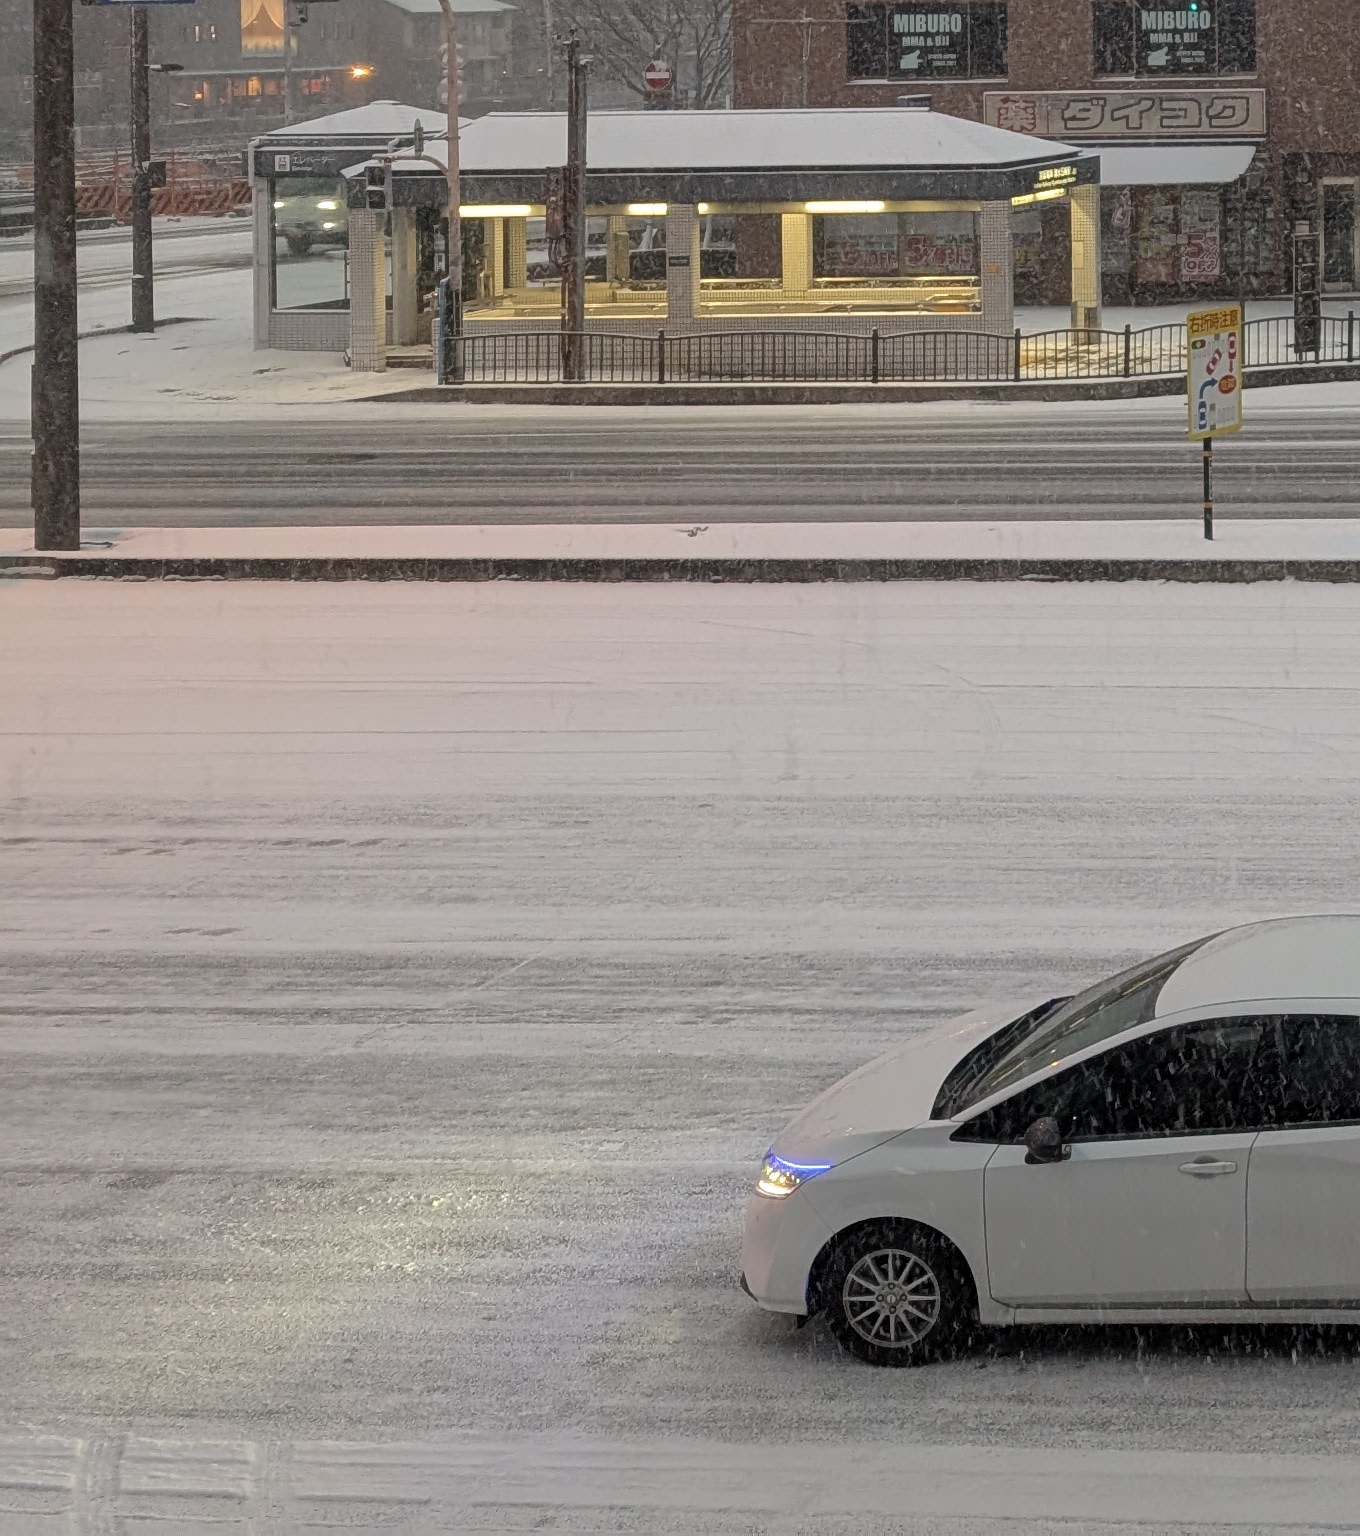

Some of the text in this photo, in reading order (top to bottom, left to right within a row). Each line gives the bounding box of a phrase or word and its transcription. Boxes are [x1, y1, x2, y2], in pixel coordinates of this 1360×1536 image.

[893, 13, 962, 33] MIBURO
[1141, 10, 1211, 30] MIBURO
[902, 35, 925, 47] MMA
[1149, 32, 1173, 44] MMA
[997, 96, 1250, 132] 薬 ダイコク
[293, 156, 336, 165] エレベーター
